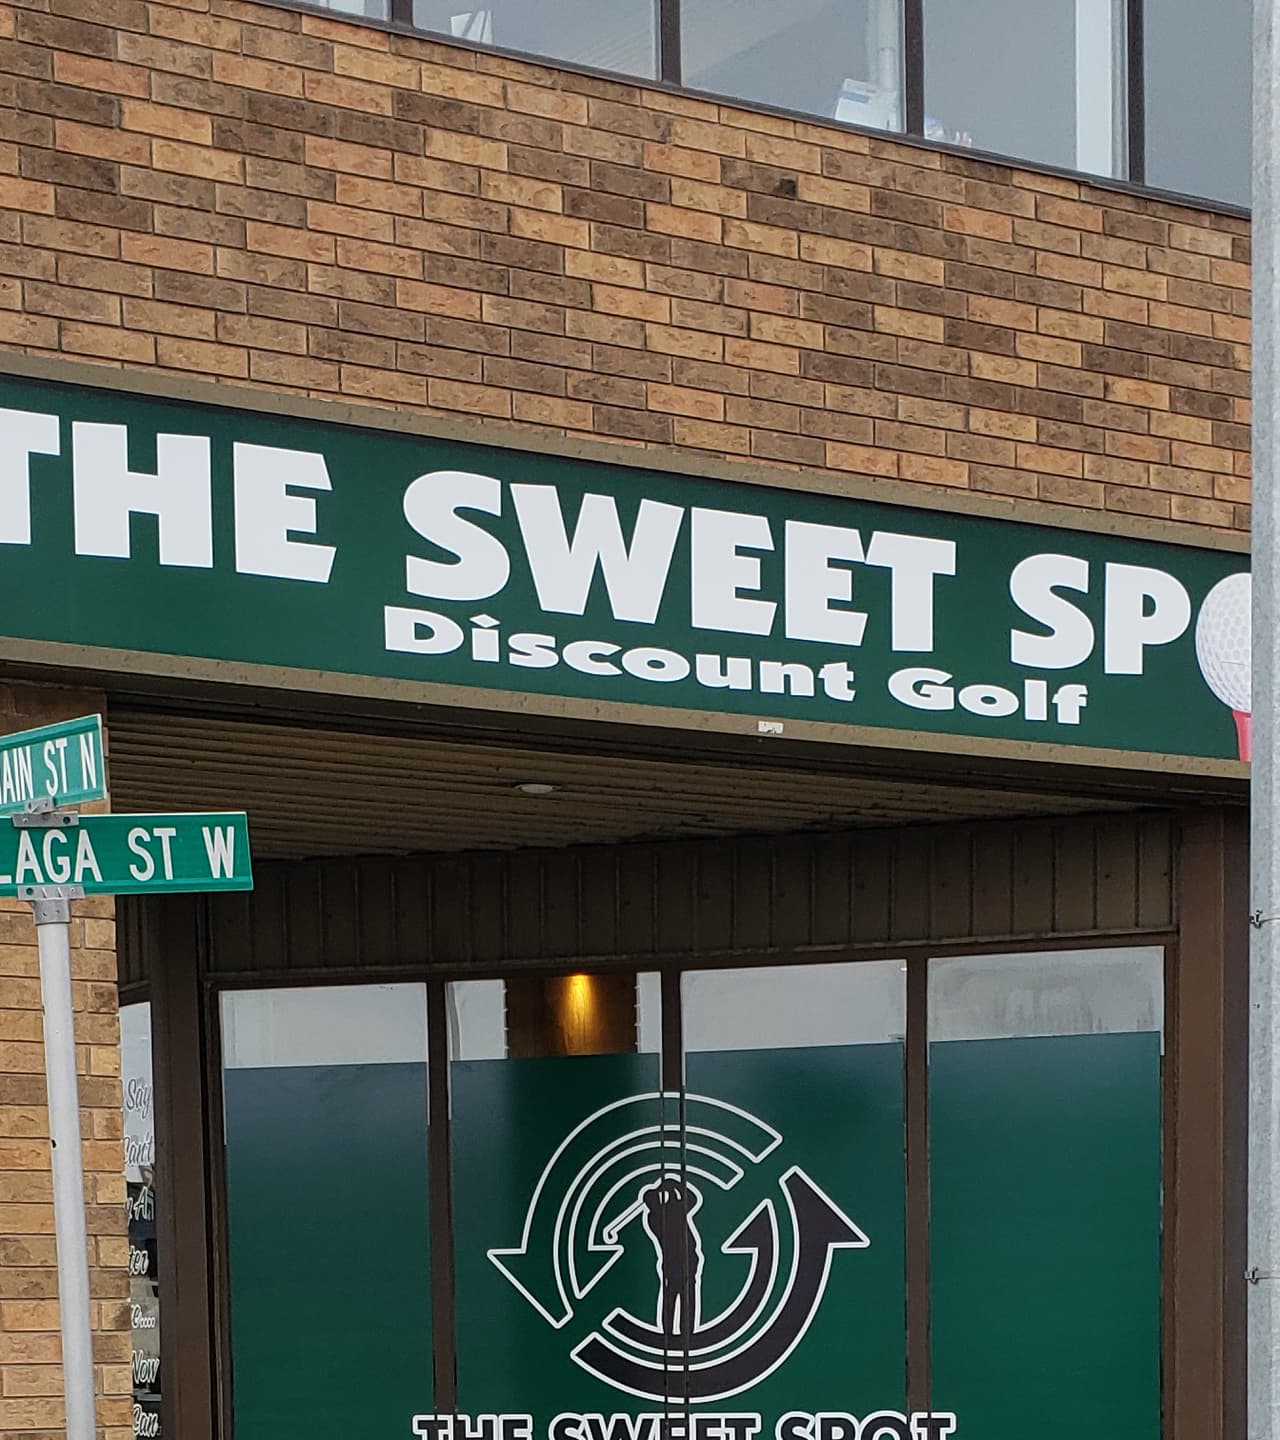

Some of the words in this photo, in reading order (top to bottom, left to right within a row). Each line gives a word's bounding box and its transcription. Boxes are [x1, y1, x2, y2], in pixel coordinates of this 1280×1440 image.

[403, 471, 956, 652] SWEET
[384, 605, 856, 702] Discount
[887, 667, 1089, 725] Golf
[44, 738, 69, 794] ST
[79, 732, 97, 790] N
[127, 827, 176, 881] ST
[202, 826, 235, 879] W
